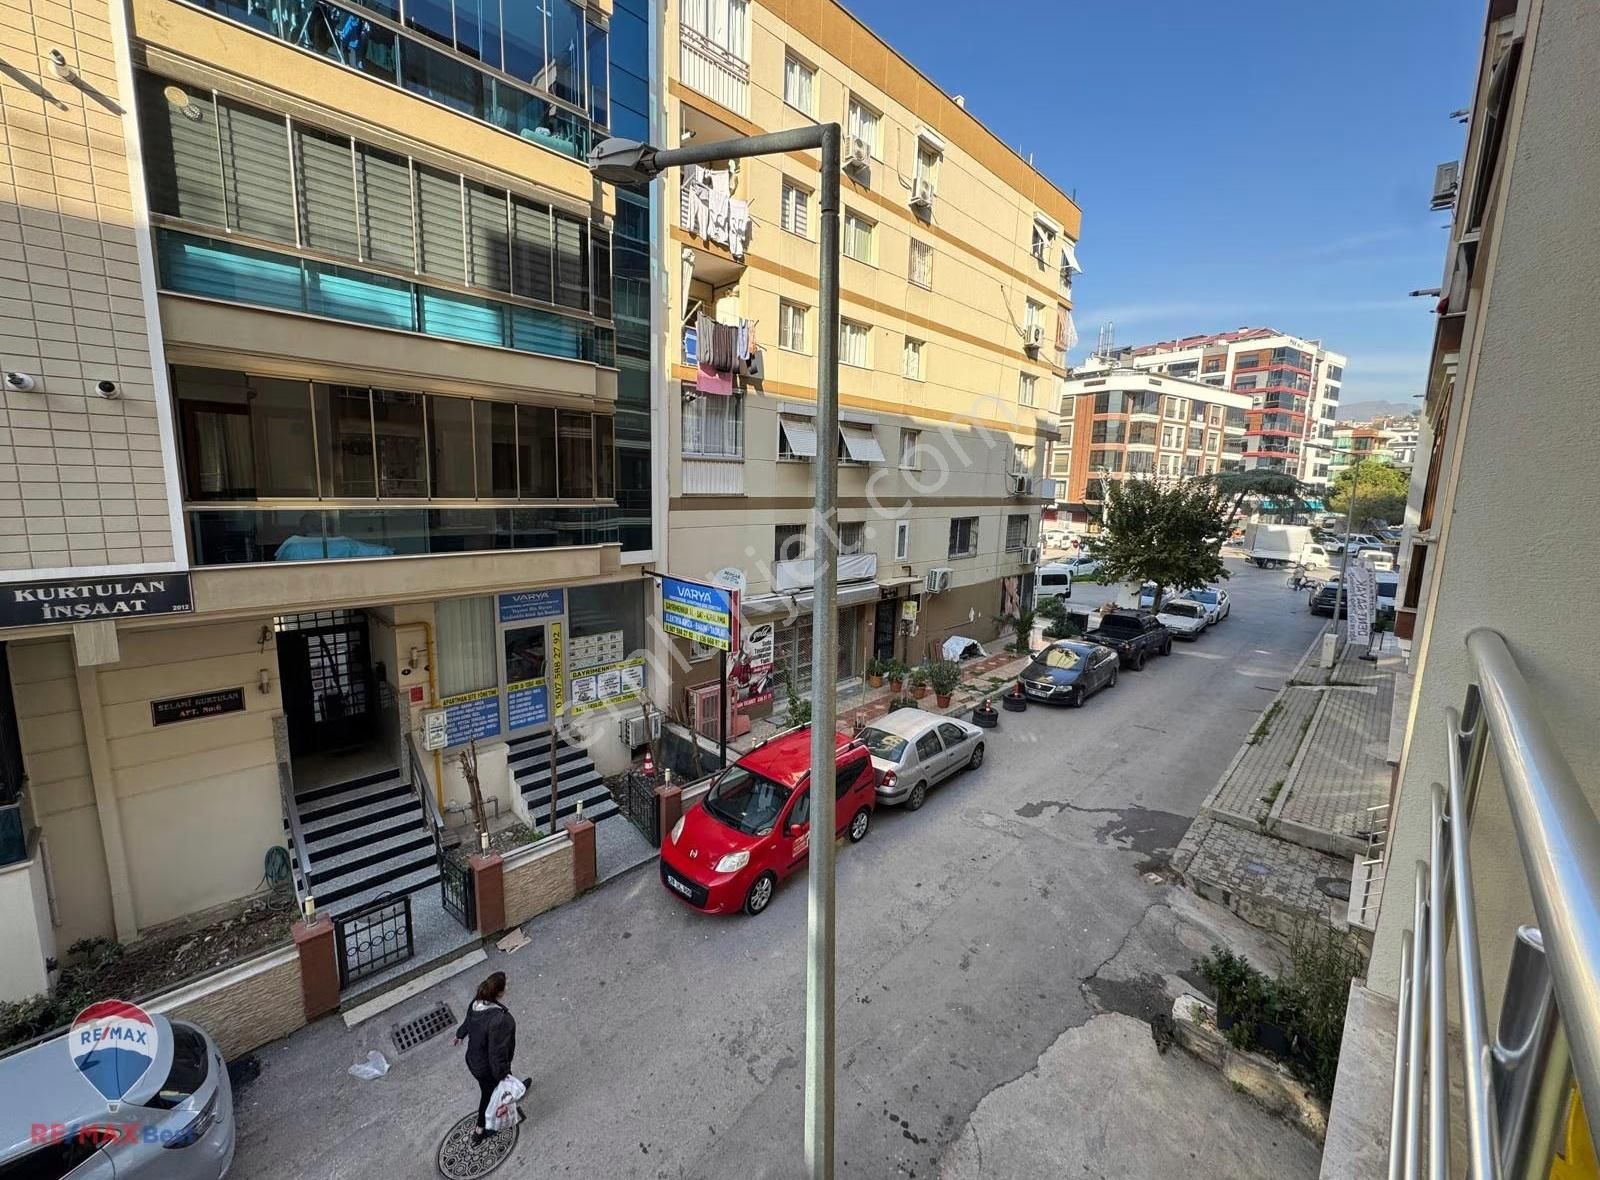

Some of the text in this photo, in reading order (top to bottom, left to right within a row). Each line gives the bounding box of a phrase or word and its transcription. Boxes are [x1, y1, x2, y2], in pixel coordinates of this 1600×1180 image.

[14, 581, 166, 602] KURTULAN
[512, 592, 549, 601] VARYA
[677, 586, 711, 603] VARYA
[42, 600, 147, 618] İNŞAAT
[552, 632, 560, 644] 92
[553, 647, 561, 659] 27
[195, 692, 239, 705] KURTULAN
